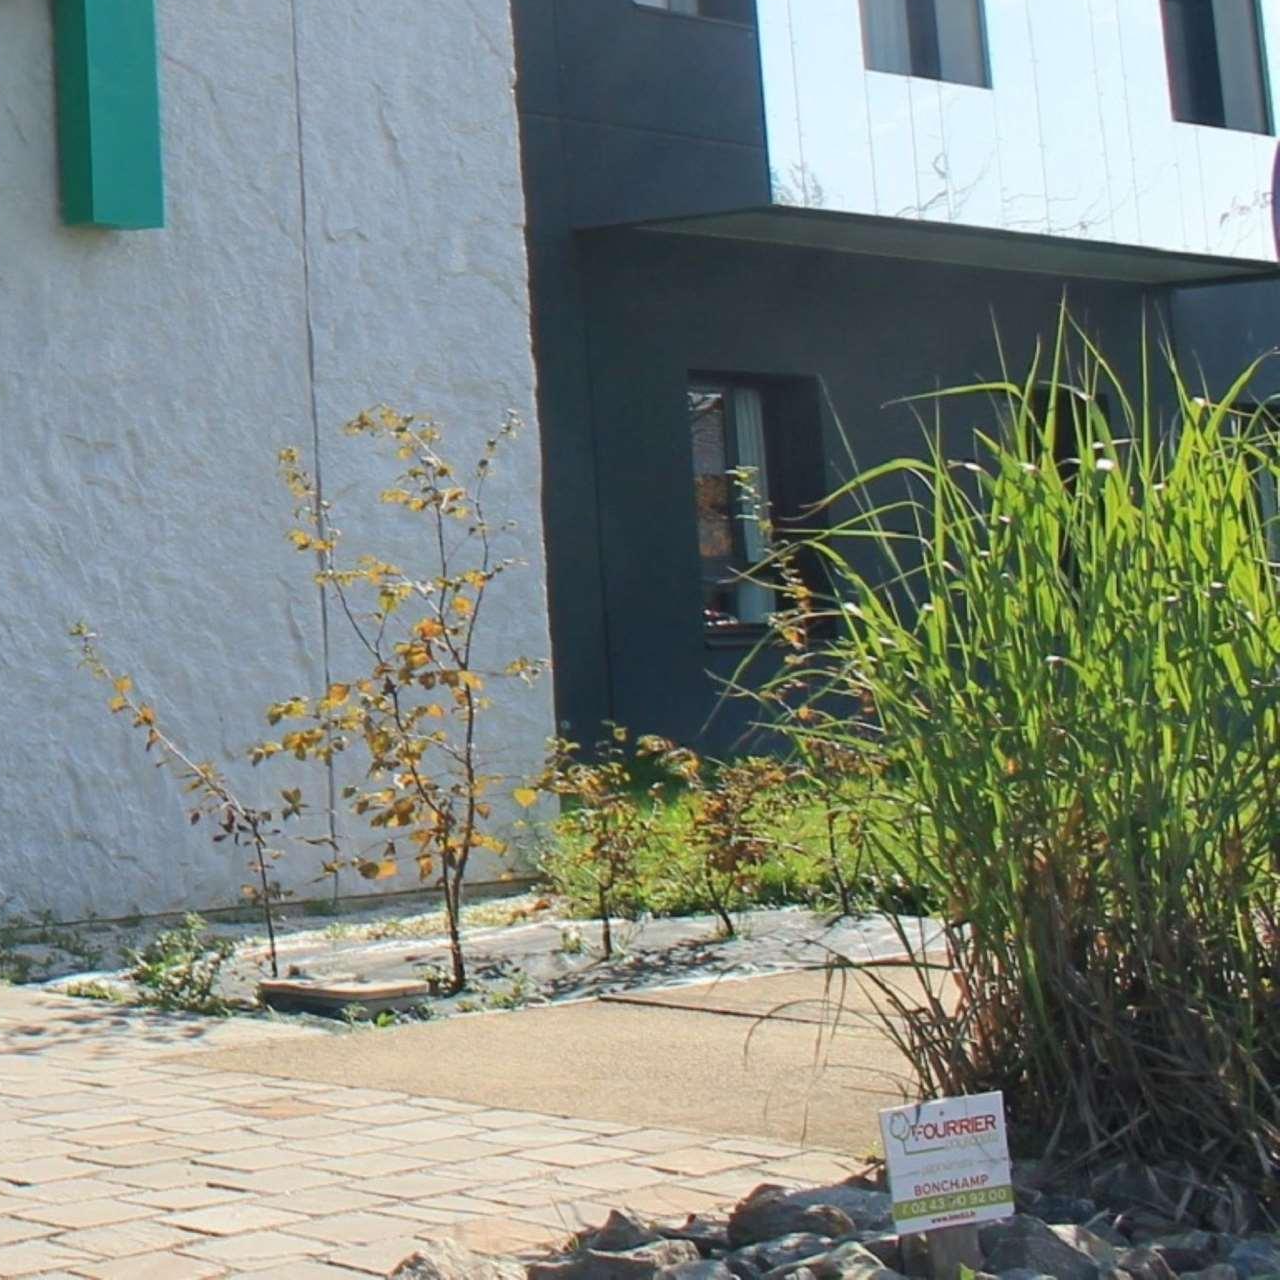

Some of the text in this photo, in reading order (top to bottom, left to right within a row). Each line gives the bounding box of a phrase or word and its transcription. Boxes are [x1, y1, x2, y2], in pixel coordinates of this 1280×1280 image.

[911, 1114, 997, 1140] FOURRIER
[914, 1174, 989, 1197] BONCHAMP
[988, 1189, 1007, 1202] 00
